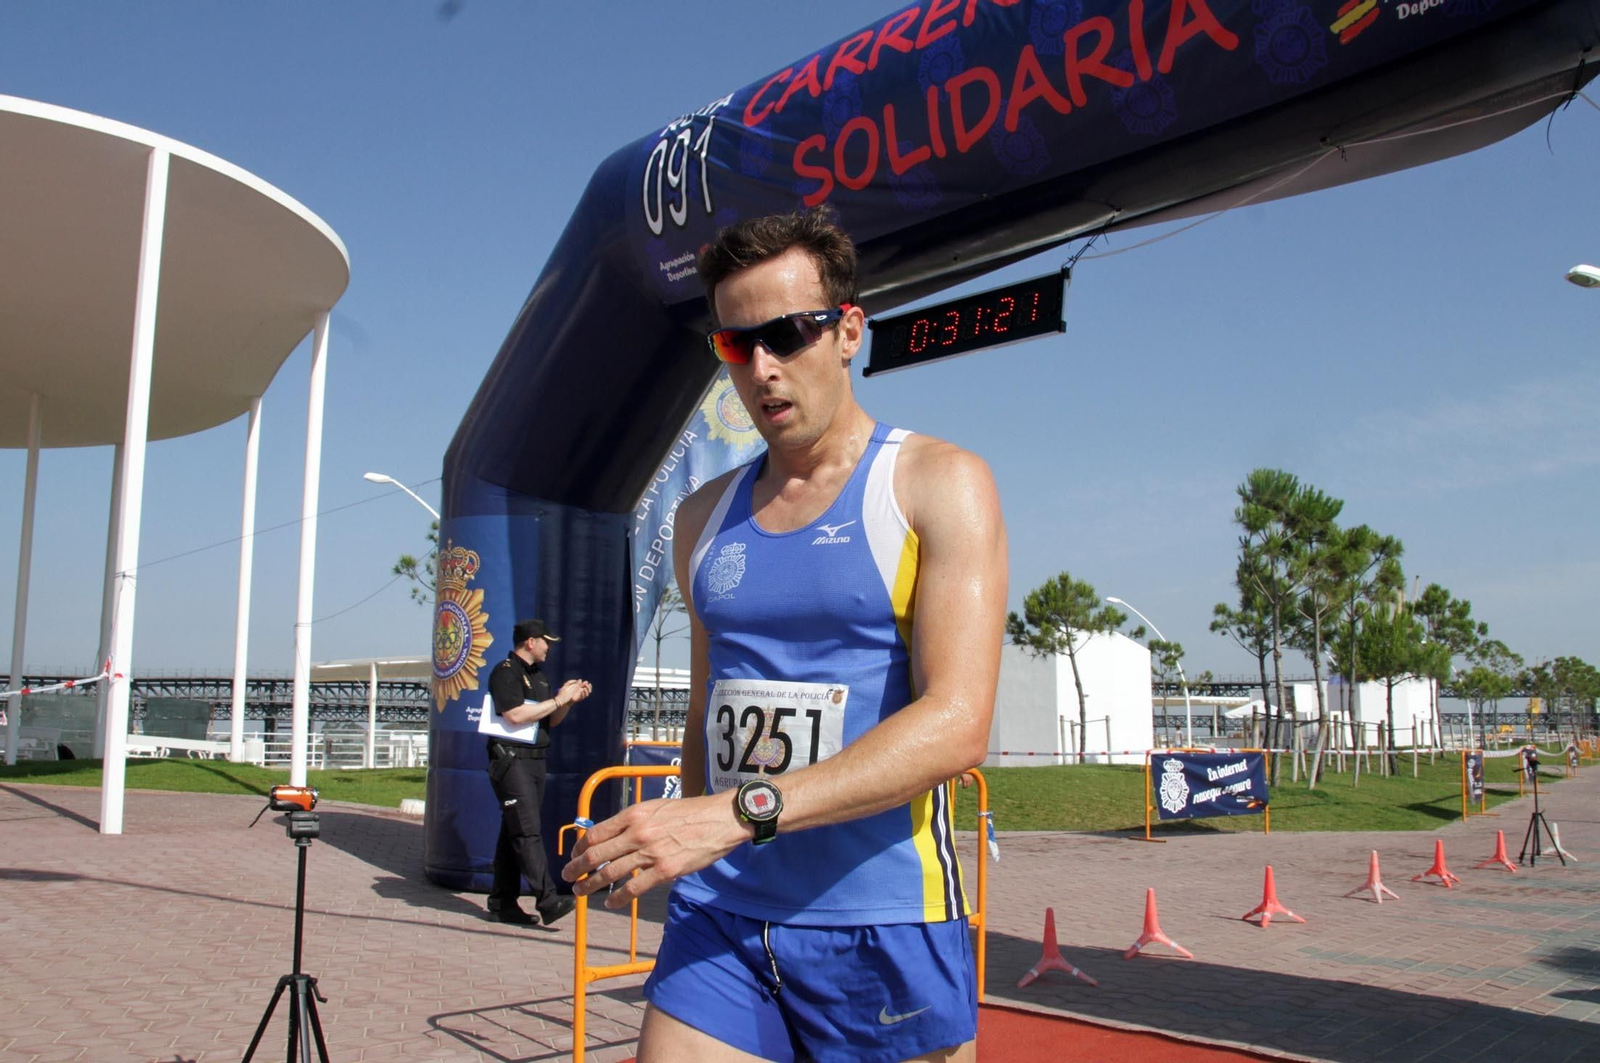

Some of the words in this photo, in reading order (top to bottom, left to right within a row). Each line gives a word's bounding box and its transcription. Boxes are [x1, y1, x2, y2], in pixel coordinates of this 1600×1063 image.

[1396, 0, 1444, 20] Depo
[743, 0, 1020, 127] CARRE
[792, 0, 1239, 208] SOLIDARIA
[643, 115, 716, 235] 091
[667, 267, 697, 282] Deportiva
[910, 292, 1040, 353] 0:31:21
[638, 475, 701, 582] DEPORTIVA
[741, 689, 776, 698] GENERAL
[776, 691, 788, 699] DE
[788, 691, 799, 700] LA
[716, 704, 822, 776] 3251
